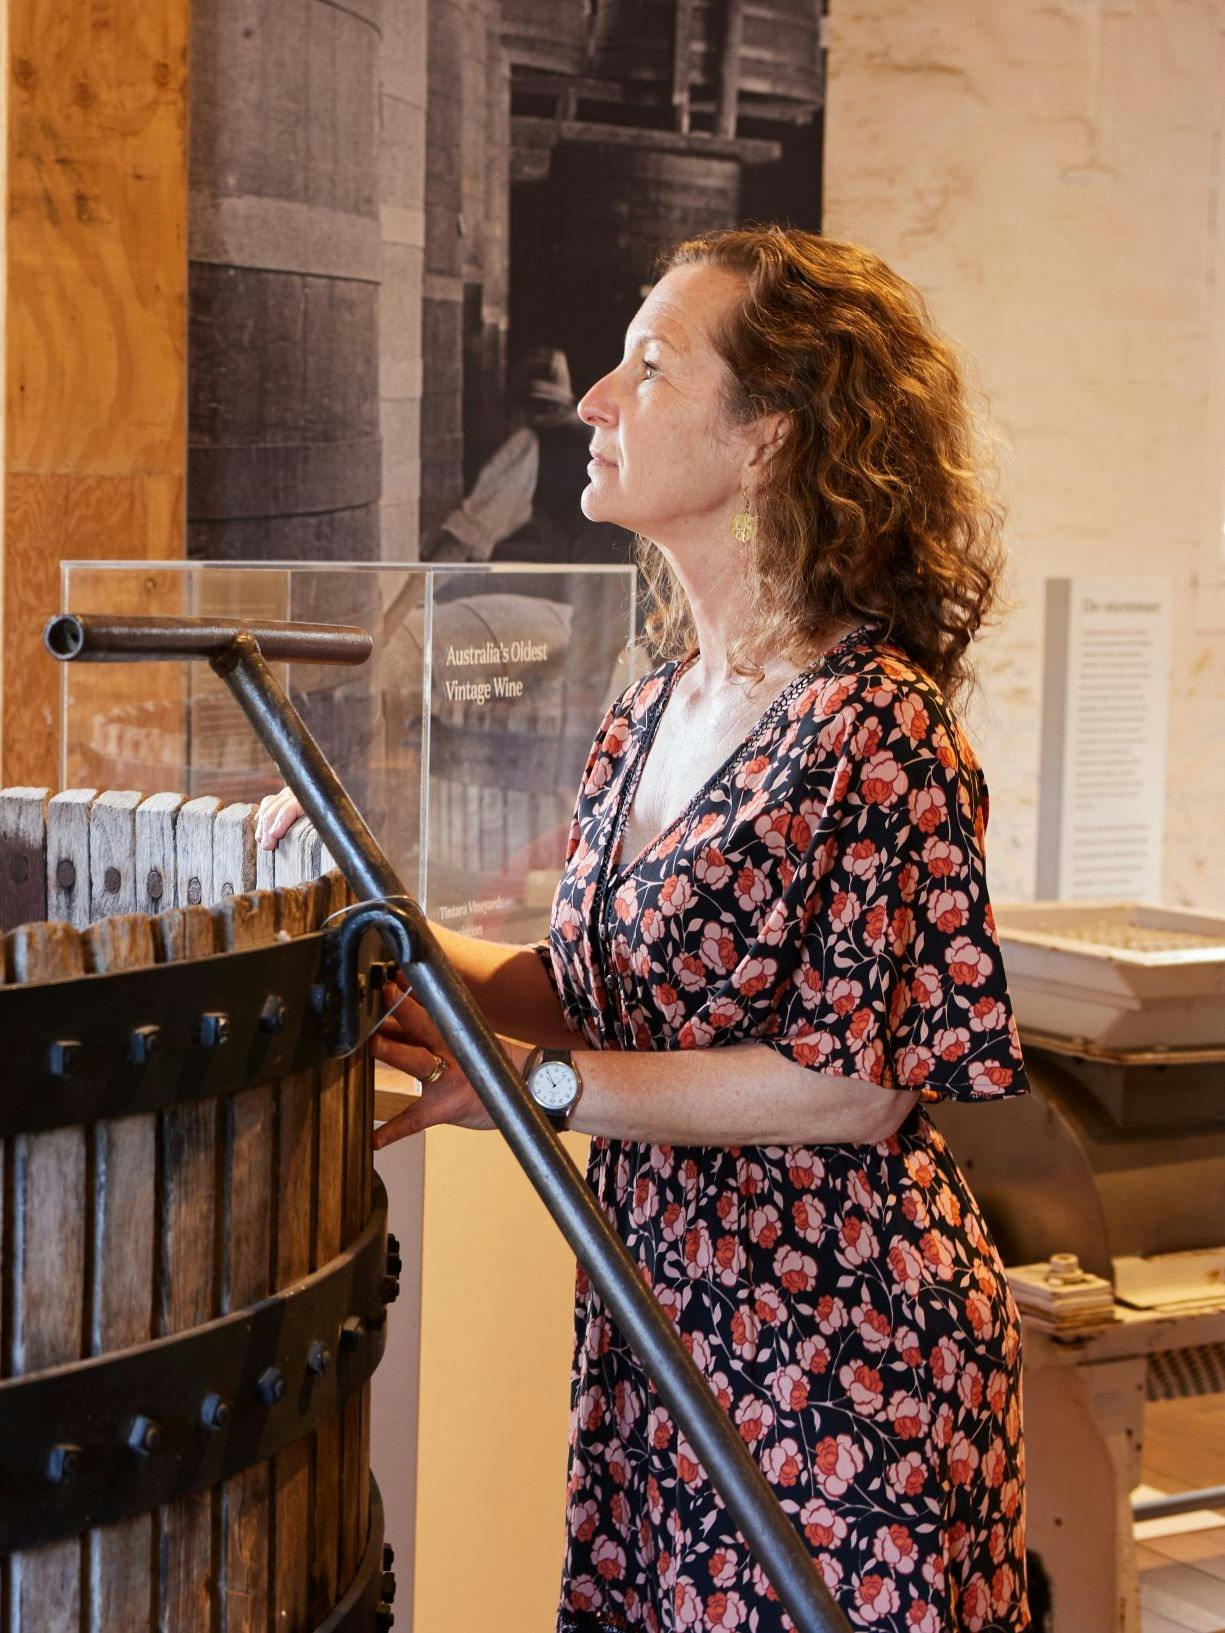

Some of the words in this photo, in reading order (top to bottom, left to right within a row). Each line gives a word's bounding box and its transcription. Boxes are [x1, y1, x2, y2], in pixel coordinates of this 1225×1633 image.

[446, 641, 509, 666] Australia's
[511, 640, 548, 662] Oldest
[445, 679, 491, 705] Vintage
[493, 677, 524, 697] Wine
[440, 906, 467, 920] Tintara
